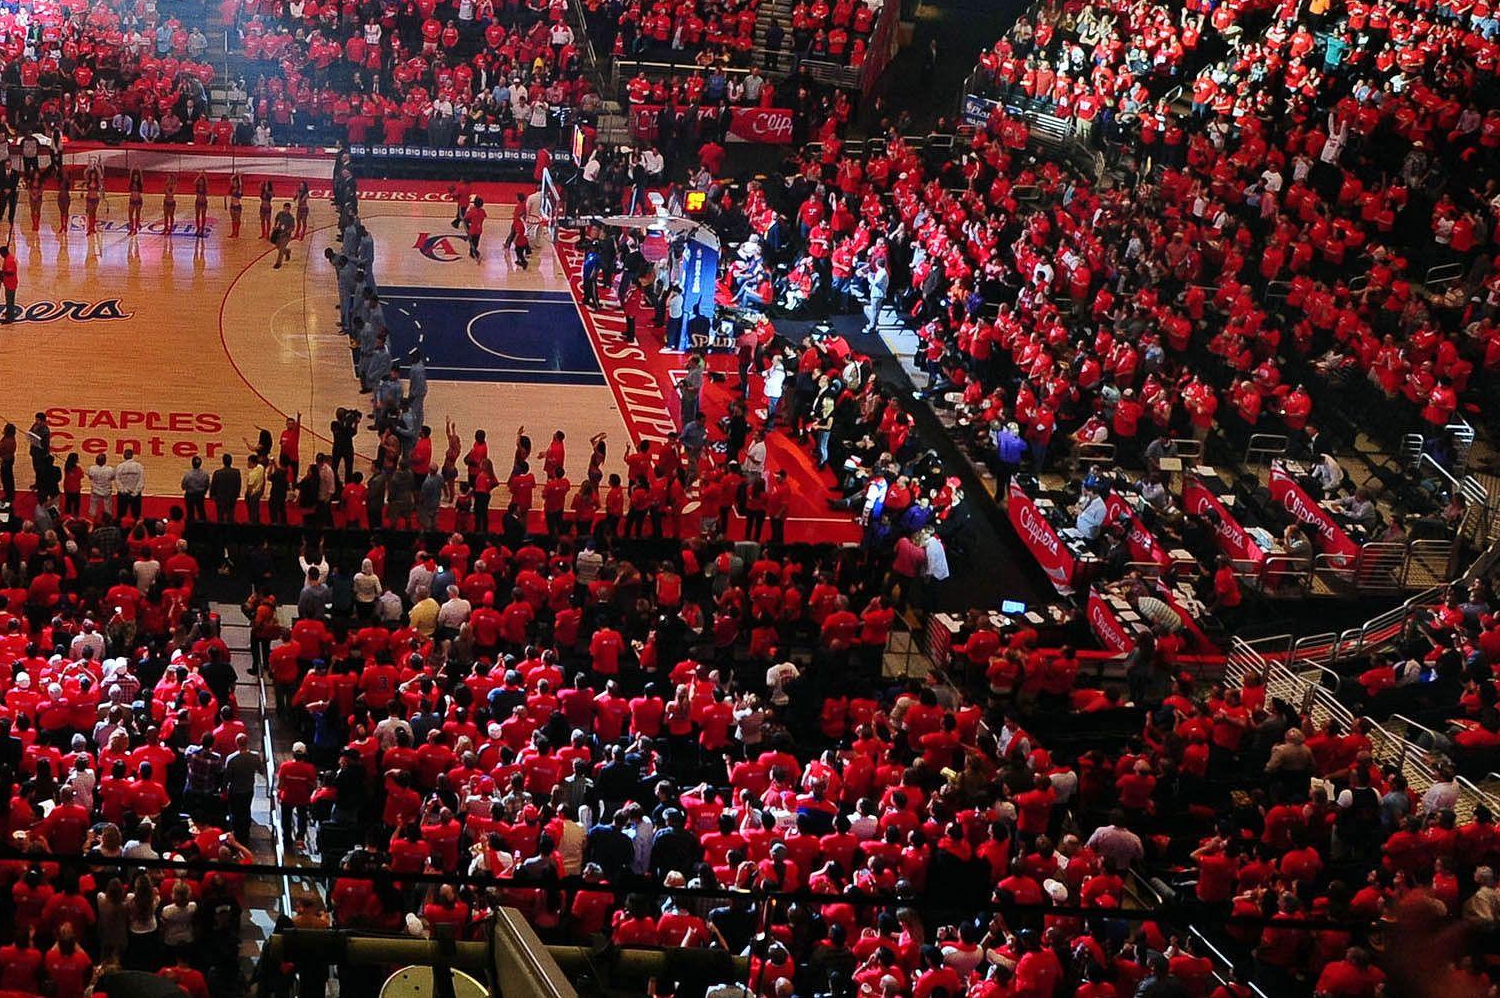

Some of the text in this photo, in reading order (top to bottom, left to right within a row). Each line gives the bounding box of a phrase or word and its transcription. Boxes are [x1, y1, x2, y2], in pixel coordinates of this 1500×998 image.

[45, 407, 223, 434] STAPLES
[47, 430, 224, 459] Center
[1019, 505, 1059, 557] Clippers
[1092, 605, 1126, 652] Clippers
